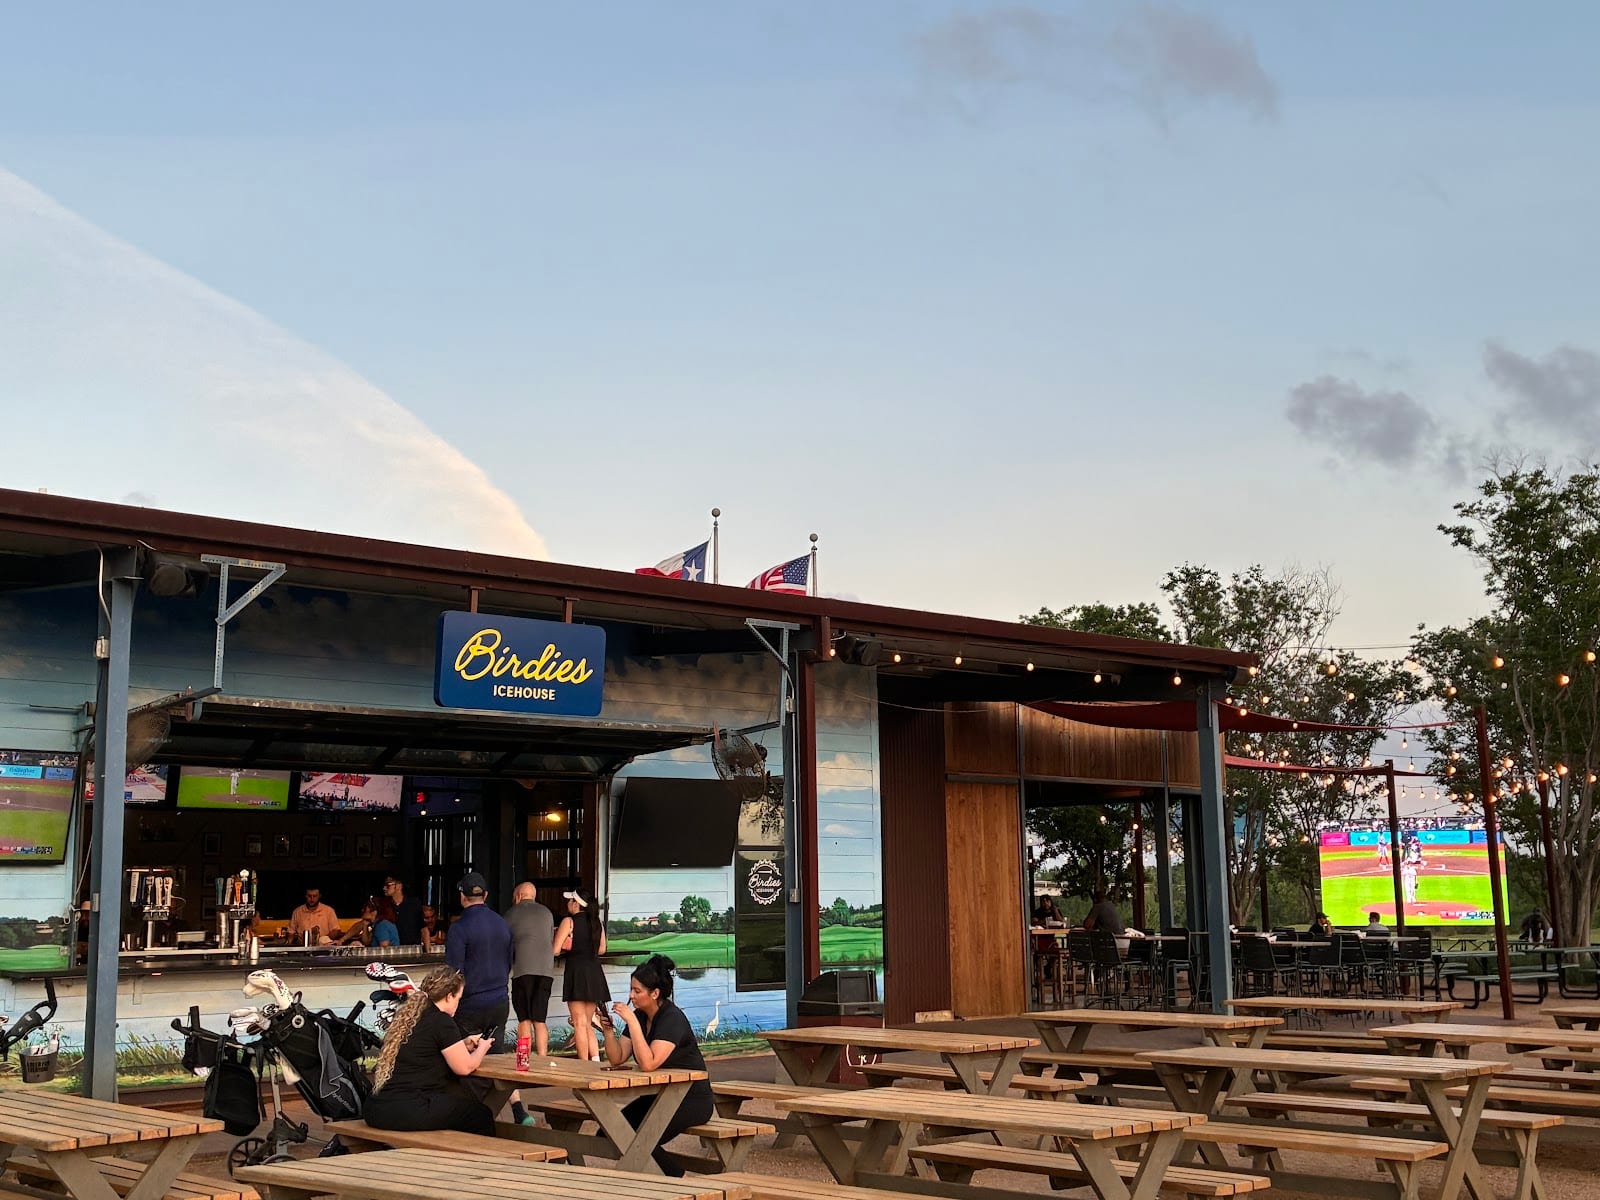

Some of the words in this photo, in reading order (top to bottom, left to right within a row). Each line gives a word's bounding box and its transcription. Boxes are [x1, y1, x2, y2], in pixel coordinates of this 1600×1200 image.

[455, 628, 594, 685] Birdies
[493, 684, 556, 701] ICEHOUSE
[748, 873, 782, 888] Birdies
